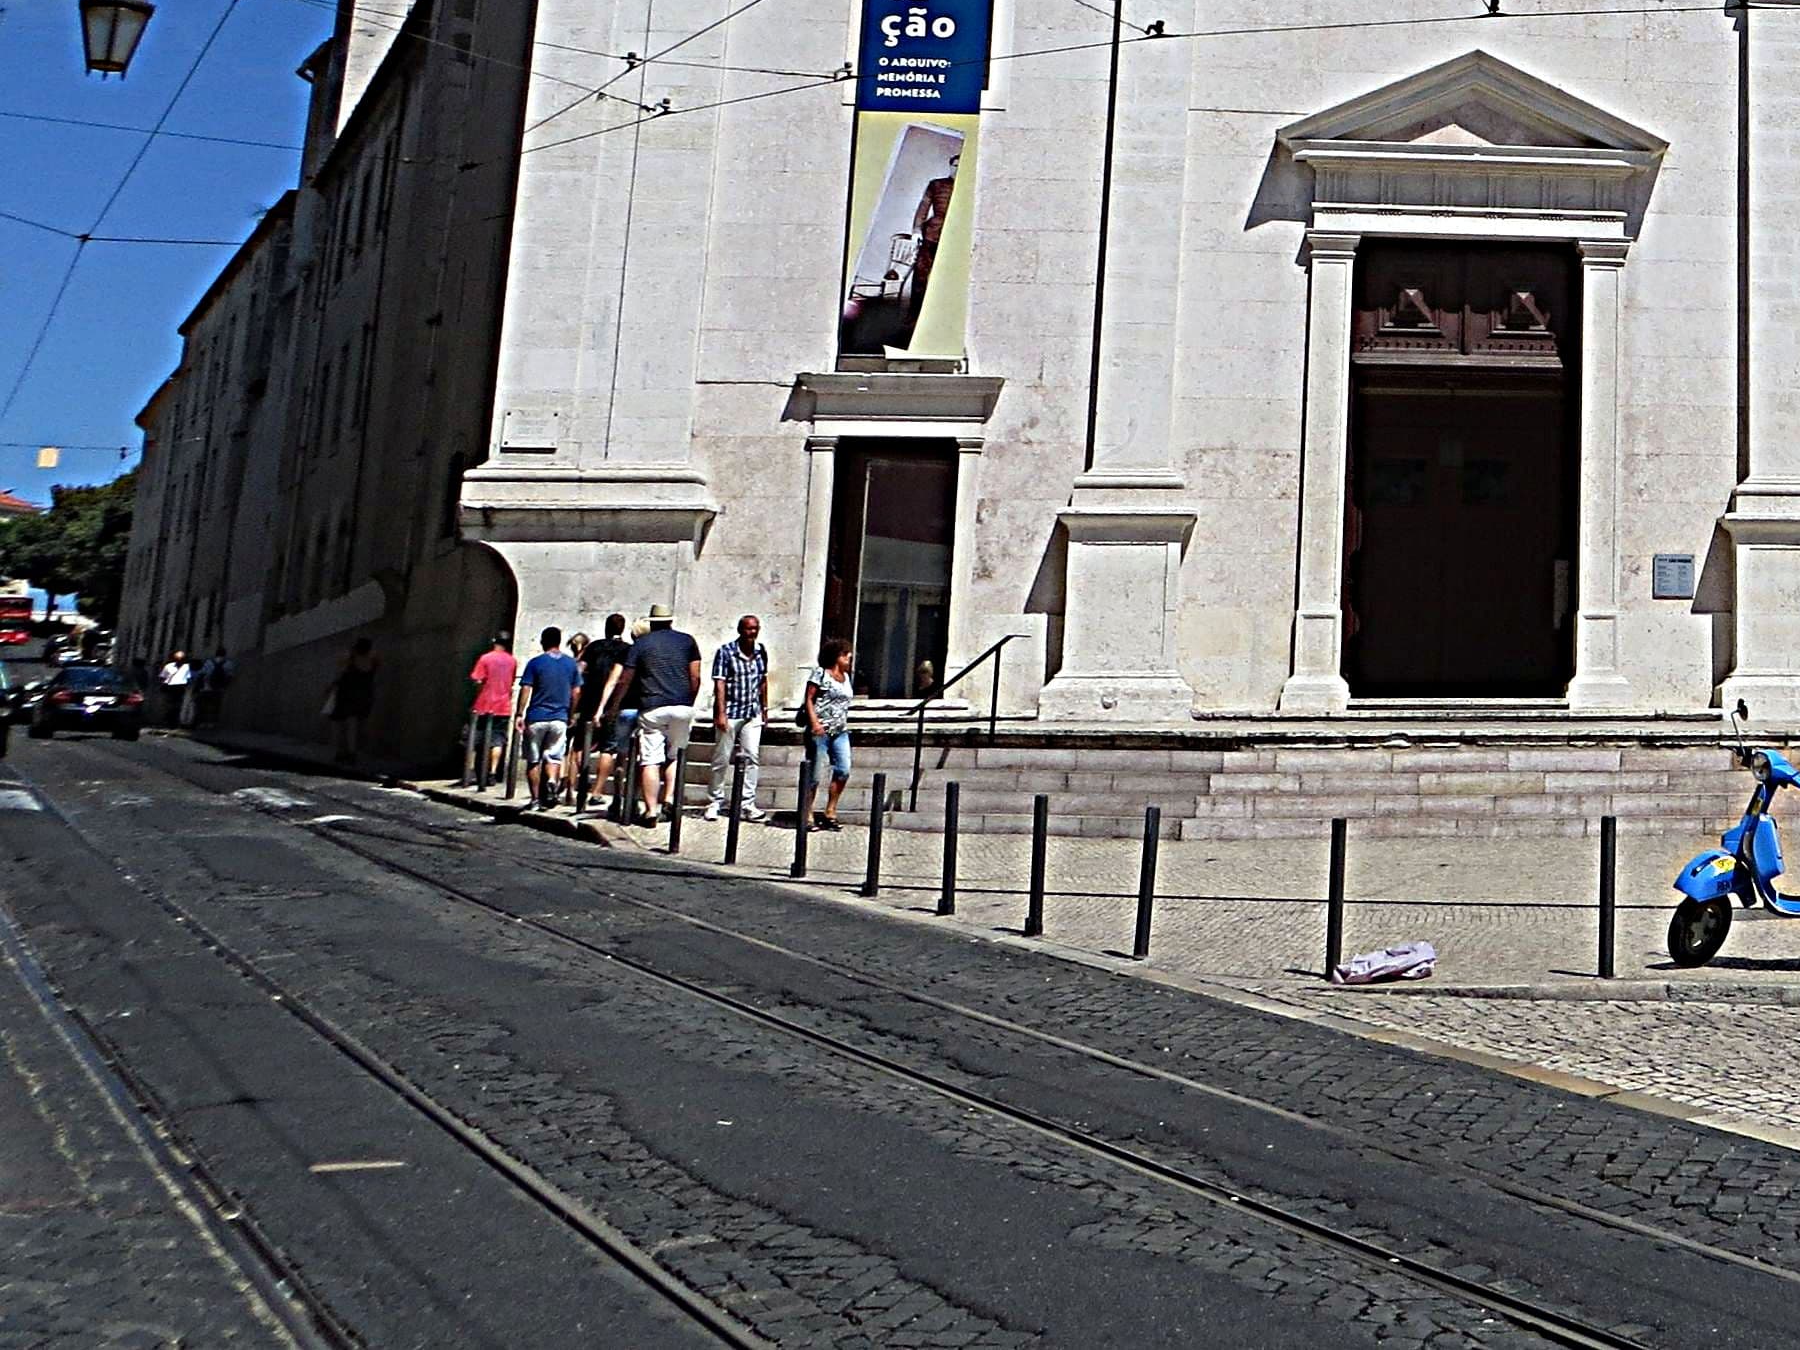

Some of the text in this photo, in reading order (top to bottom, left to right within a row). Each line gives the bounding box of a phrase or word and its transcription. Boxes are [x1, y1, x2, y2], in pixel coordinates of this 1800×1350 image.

[879, 57, 952, 69] O ARQUIVO:
[877, 71, 946, 84] MEMÓRIA E
[876, 87, 941, 99] PROMESSA
